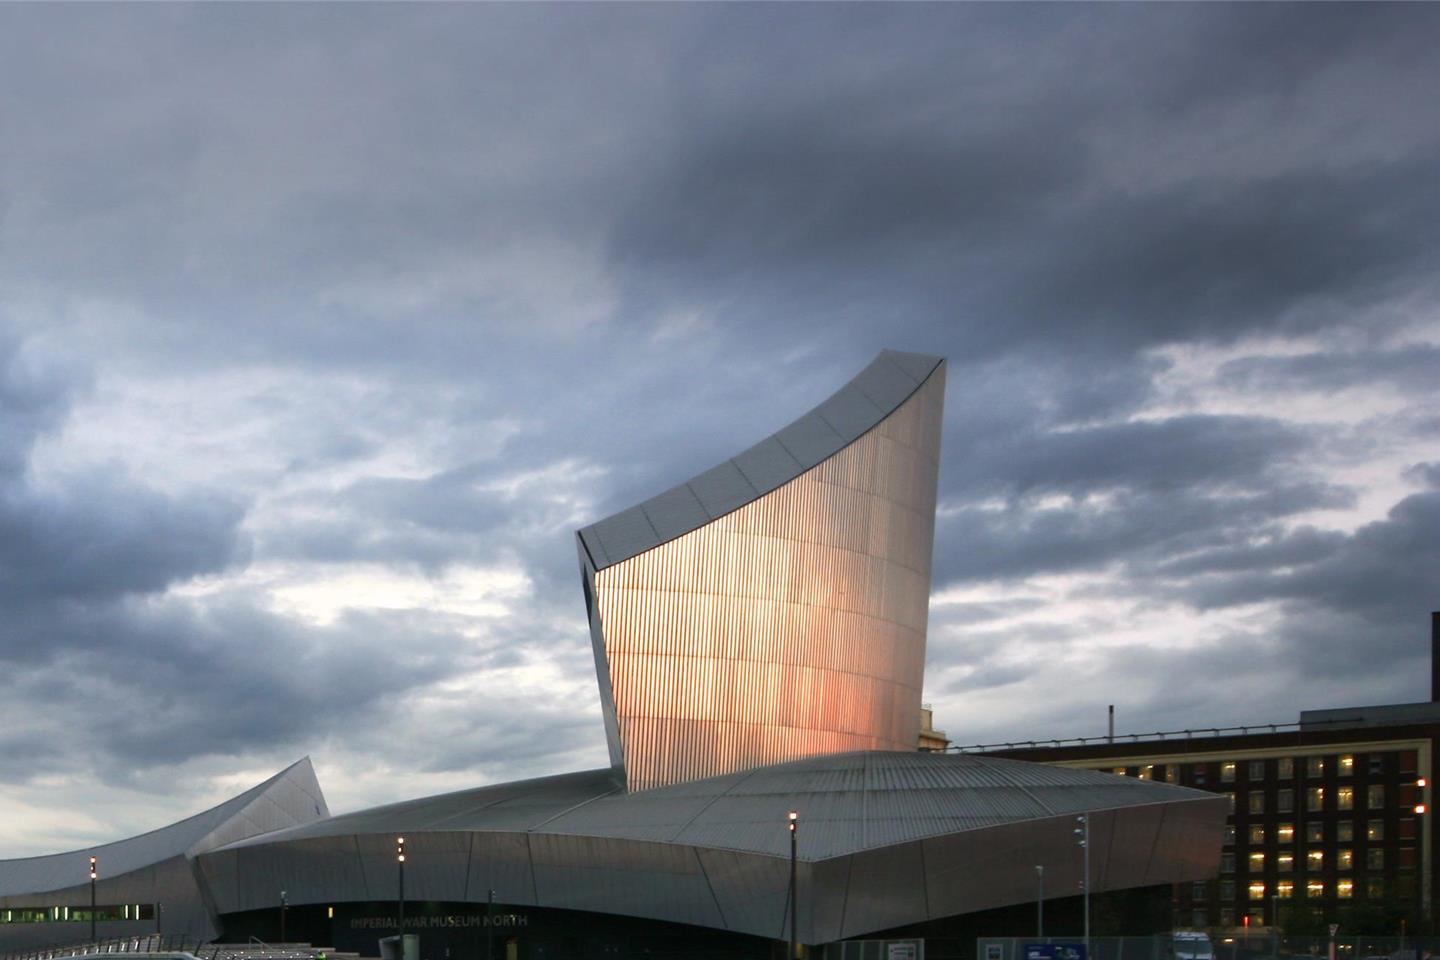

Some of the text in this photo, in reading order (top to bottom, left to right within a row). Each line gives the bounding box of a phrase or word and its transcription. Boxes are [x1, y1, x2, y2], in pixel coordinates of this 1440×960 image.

[351, 914, 528, 929] IMPERIAL WAR MUSEUM NORTH
